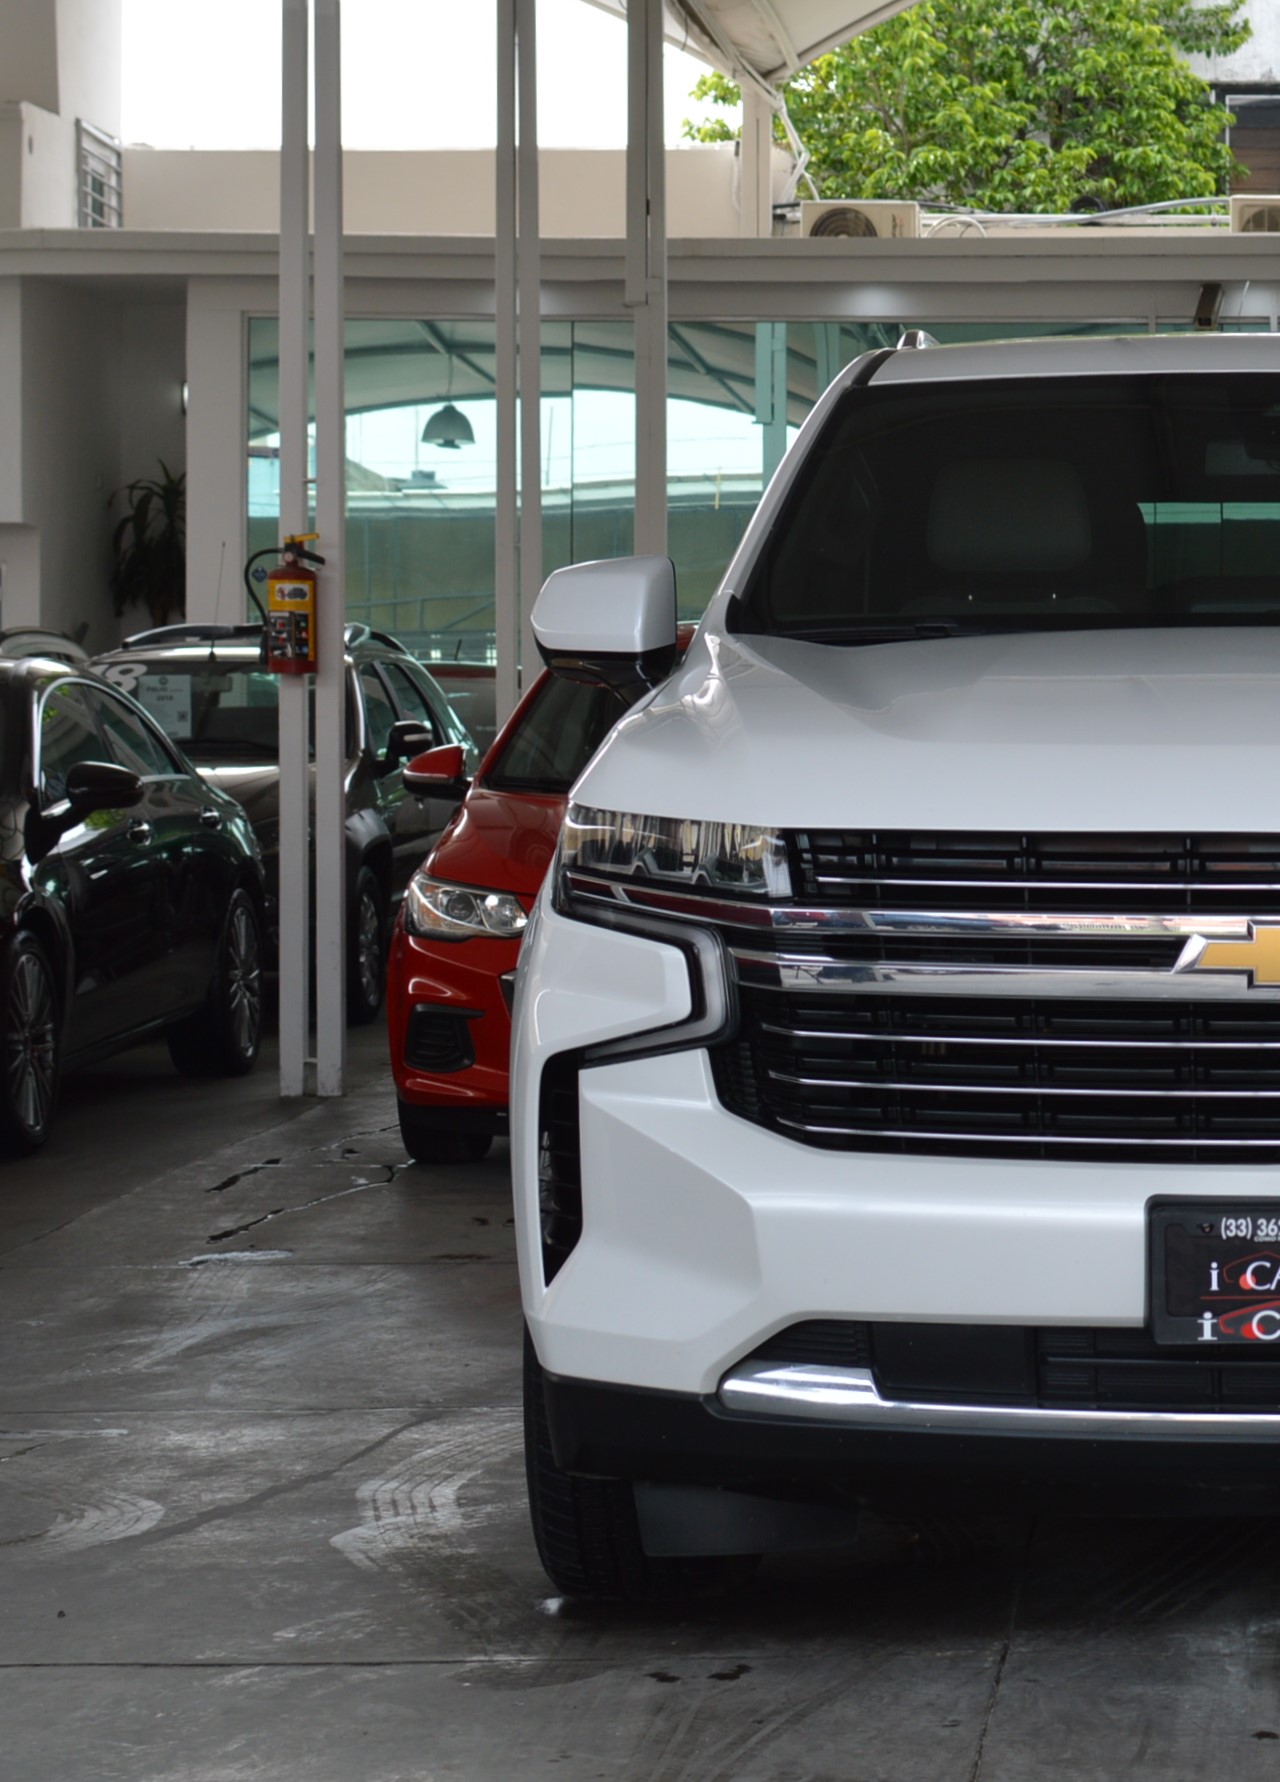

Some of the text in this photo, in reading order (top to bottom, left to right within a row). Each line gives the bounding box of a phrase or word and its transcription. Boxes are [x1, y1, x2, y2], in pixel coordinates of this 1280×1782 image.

[88, 663, 148, 692] 8
[1221, 1216, 1253, 1241] (33)
[1209, 1261, 1221, 1291] i
[1197, 1311, 1218, 1341] i
